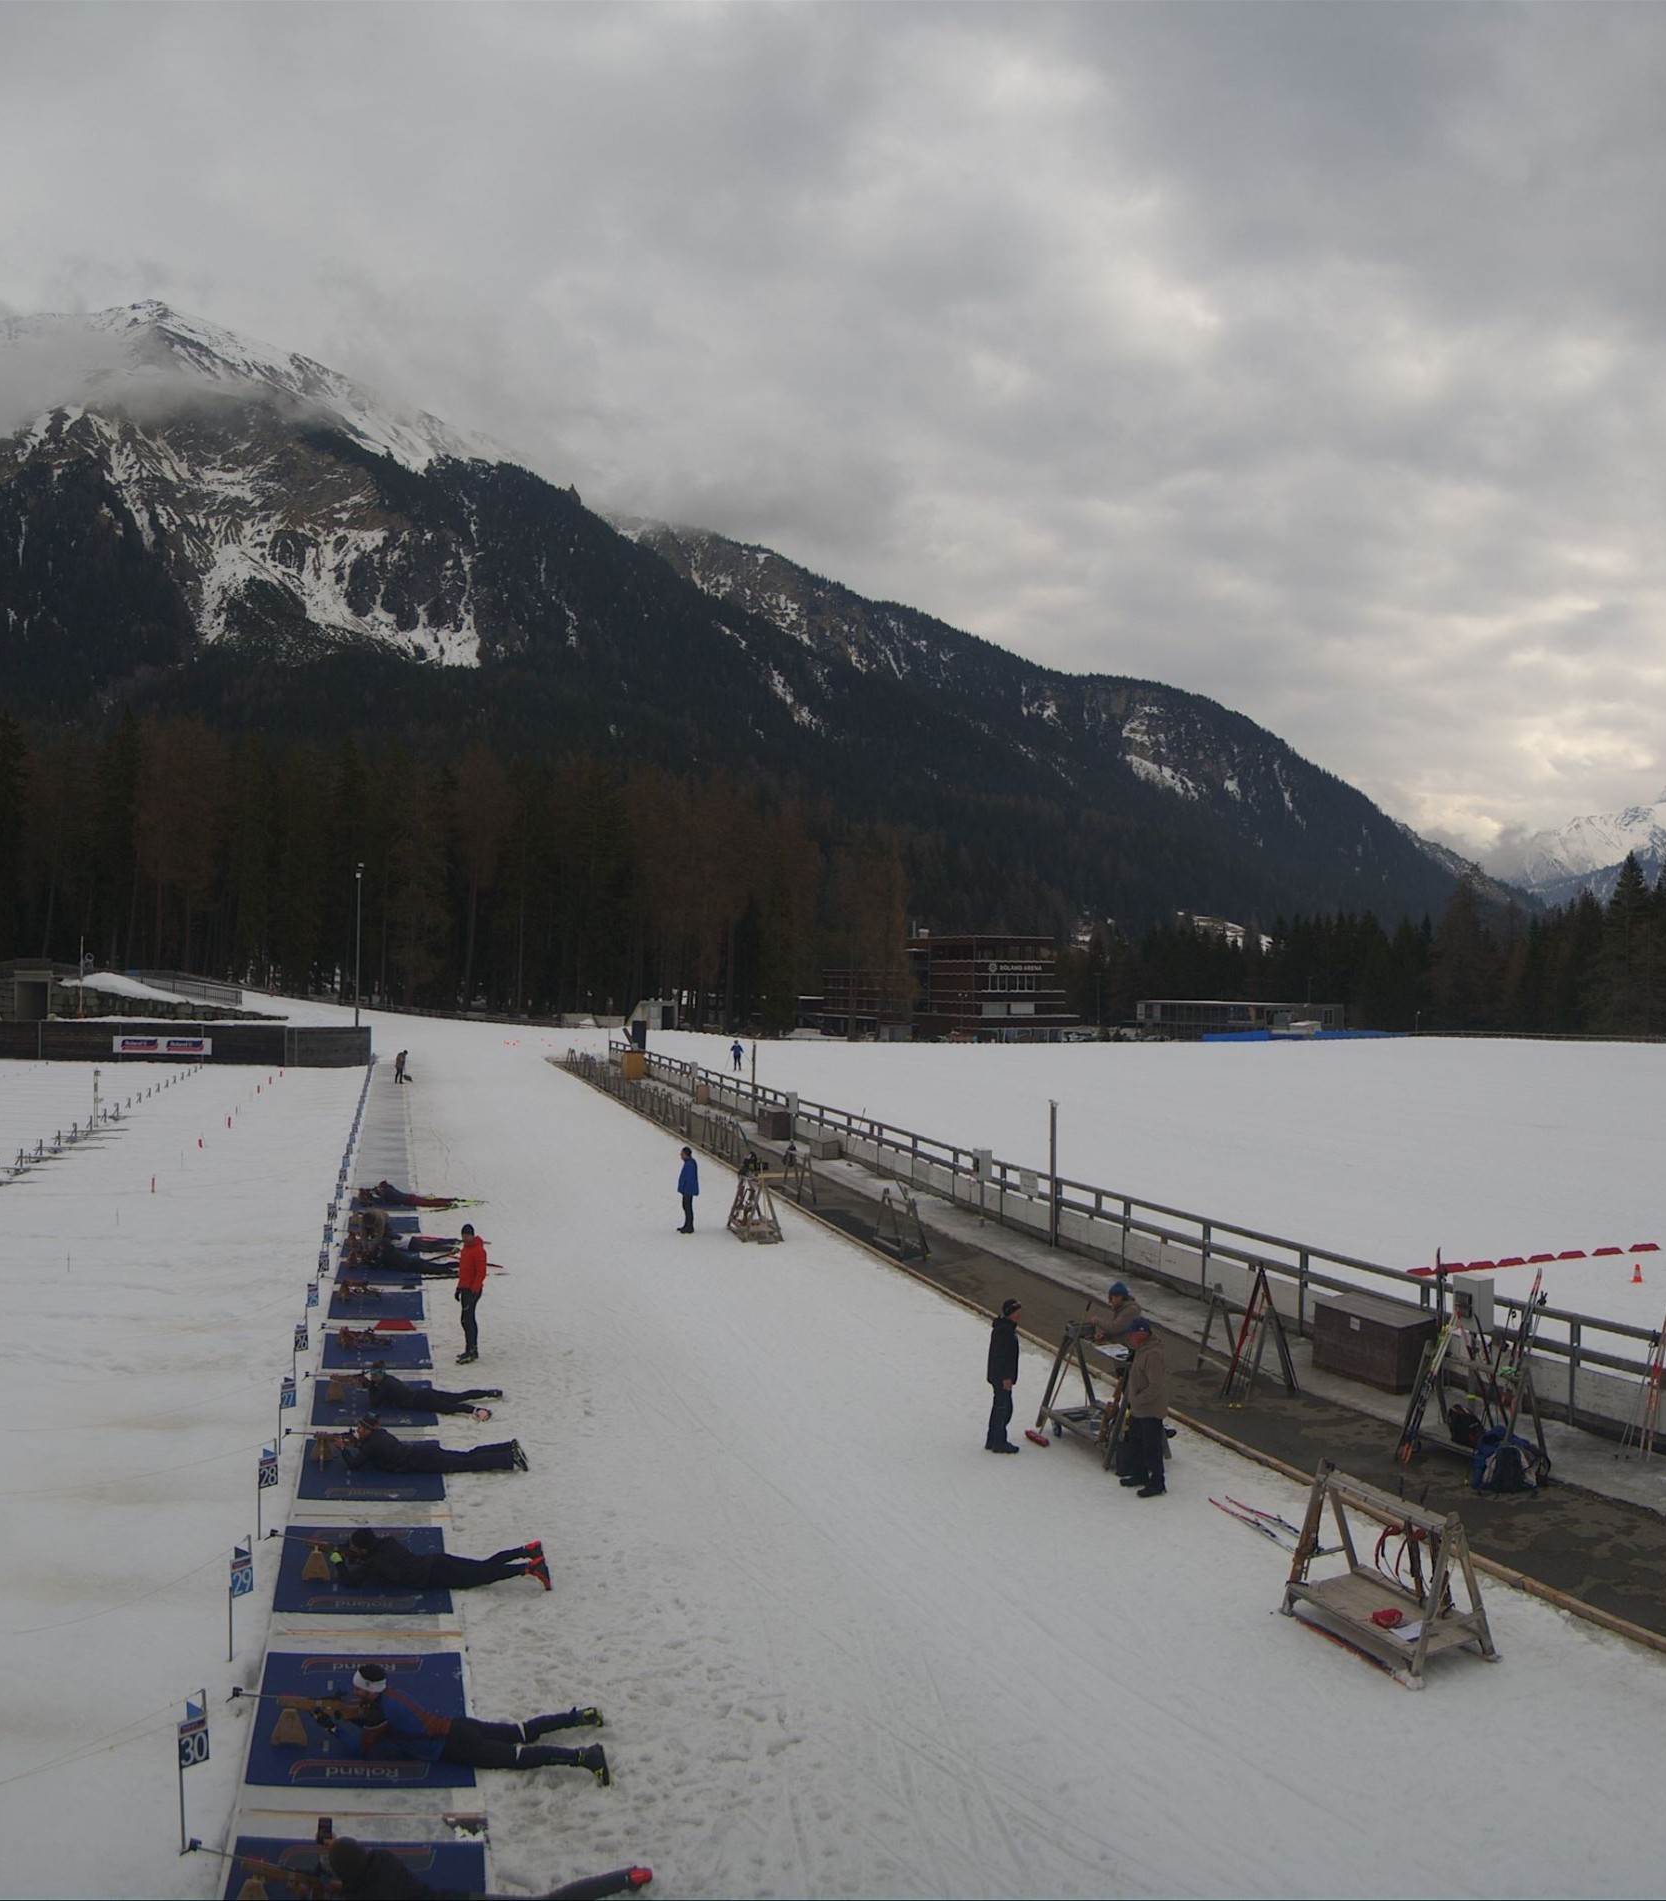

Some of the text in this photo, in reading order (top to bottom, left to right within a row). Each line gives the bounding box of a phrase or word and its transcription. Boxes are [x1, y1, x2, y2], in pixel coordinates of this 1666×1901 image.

[295, 1336, 308, 1351] 26
[281, 1391, 295, 1408] 27
[260, 1466, 278, 1488] 28
[233, 1568, 253, 1597] 29
[180, 1731, 208, 1766] 30
[325, 1766, 400, 1779] Roland
